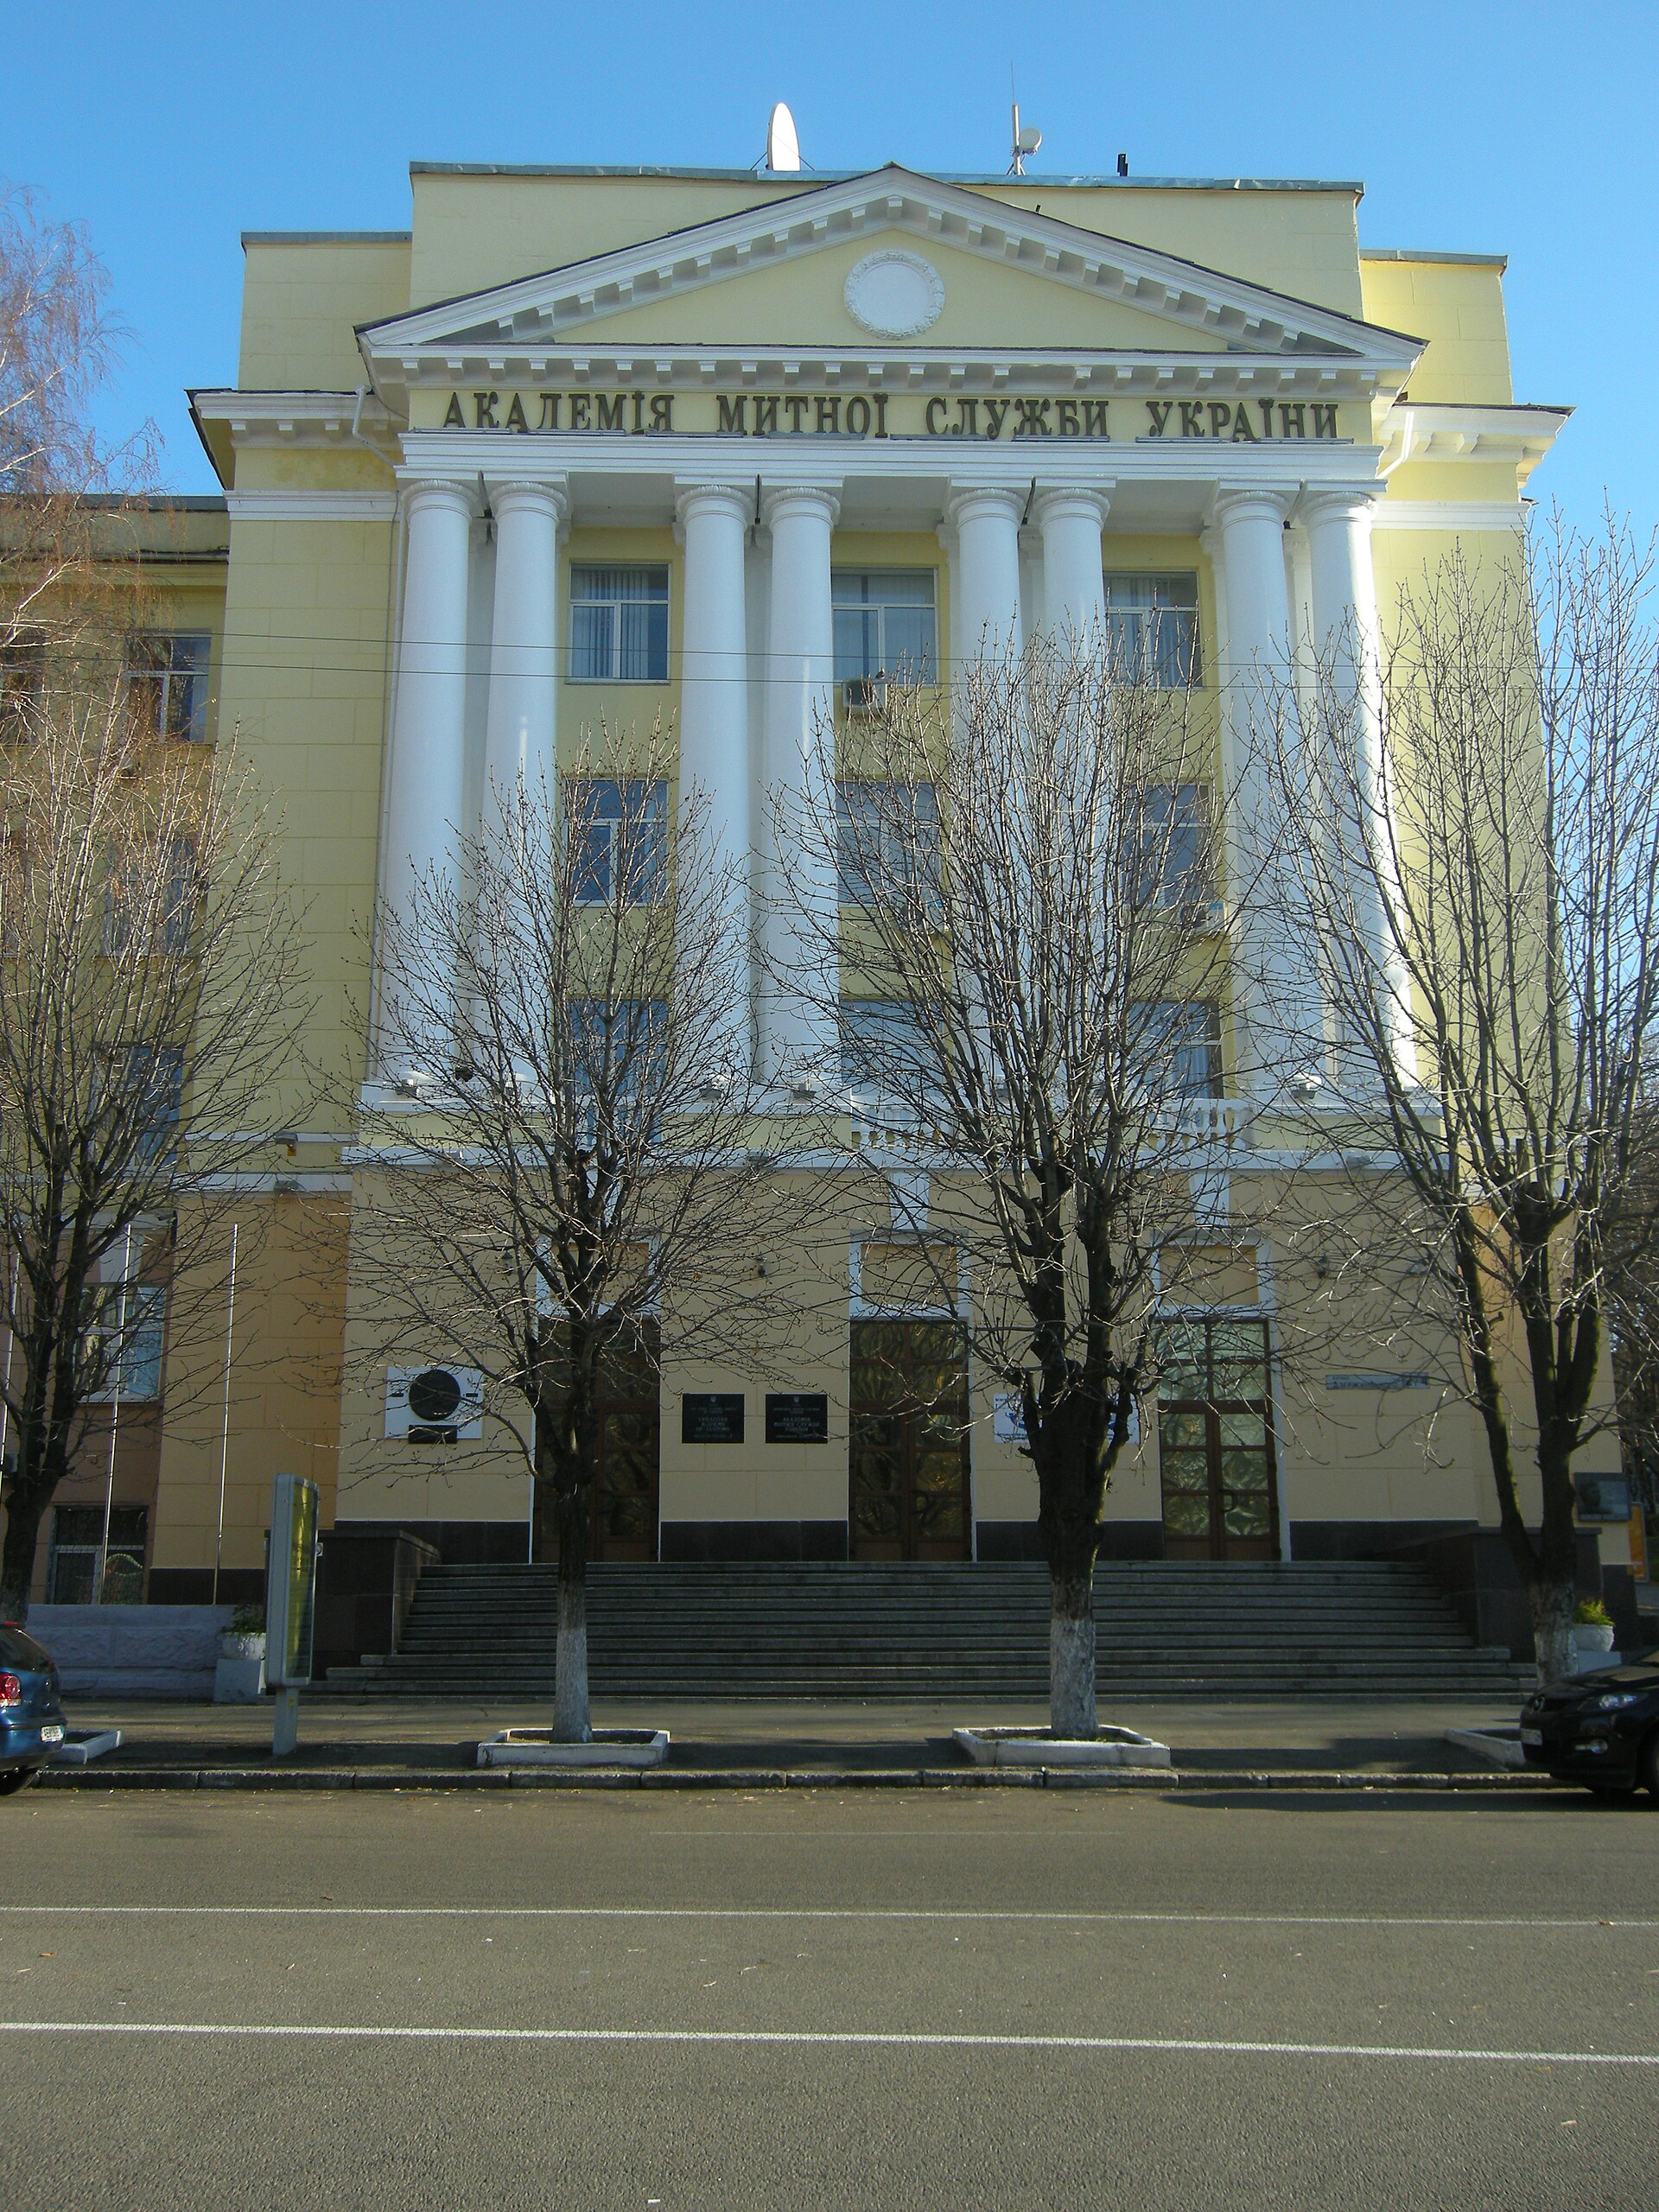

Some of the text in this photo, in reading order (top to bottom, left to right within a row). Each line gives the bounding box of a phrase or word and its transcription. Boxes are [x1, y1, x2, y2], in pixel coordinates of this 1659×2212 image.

[442, 391, 1338, 442] АКАДЕМІЯ МИТНОЇ СЛУЖБИ УКРАЇНИ
